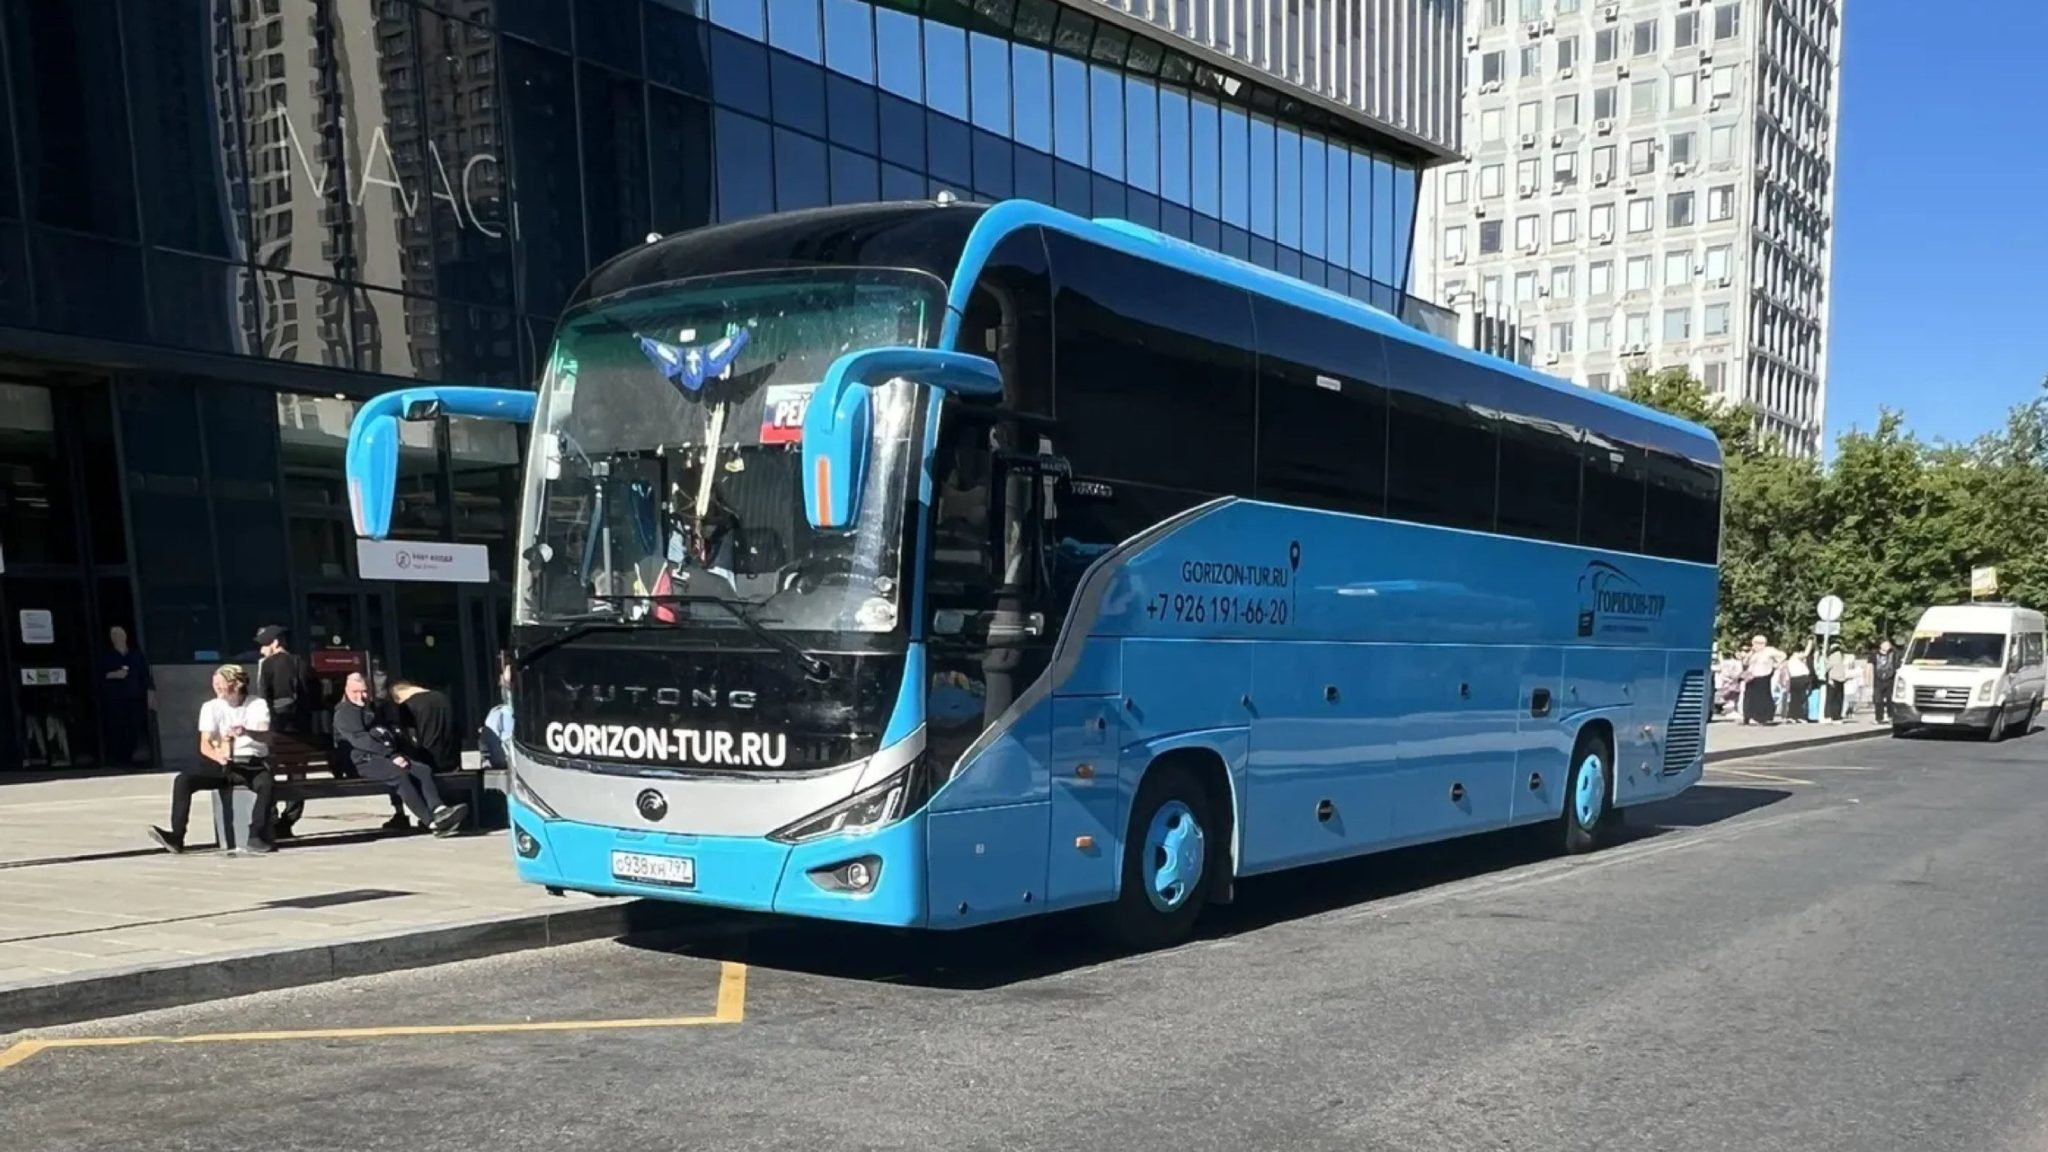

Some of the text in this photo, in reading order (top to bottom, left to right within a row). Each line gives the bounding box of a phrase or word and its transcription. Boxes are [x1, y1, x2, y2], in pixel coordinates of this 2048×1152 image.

[1182, 560, 1288, 588] GORIZON-TUR.RU
[1146, 593, 1288, 625] +7 926 191-66-20
[562, 680, 758, 708] YUTONG
[546, 721, 787, 768] GORIZON-TUR.RU
